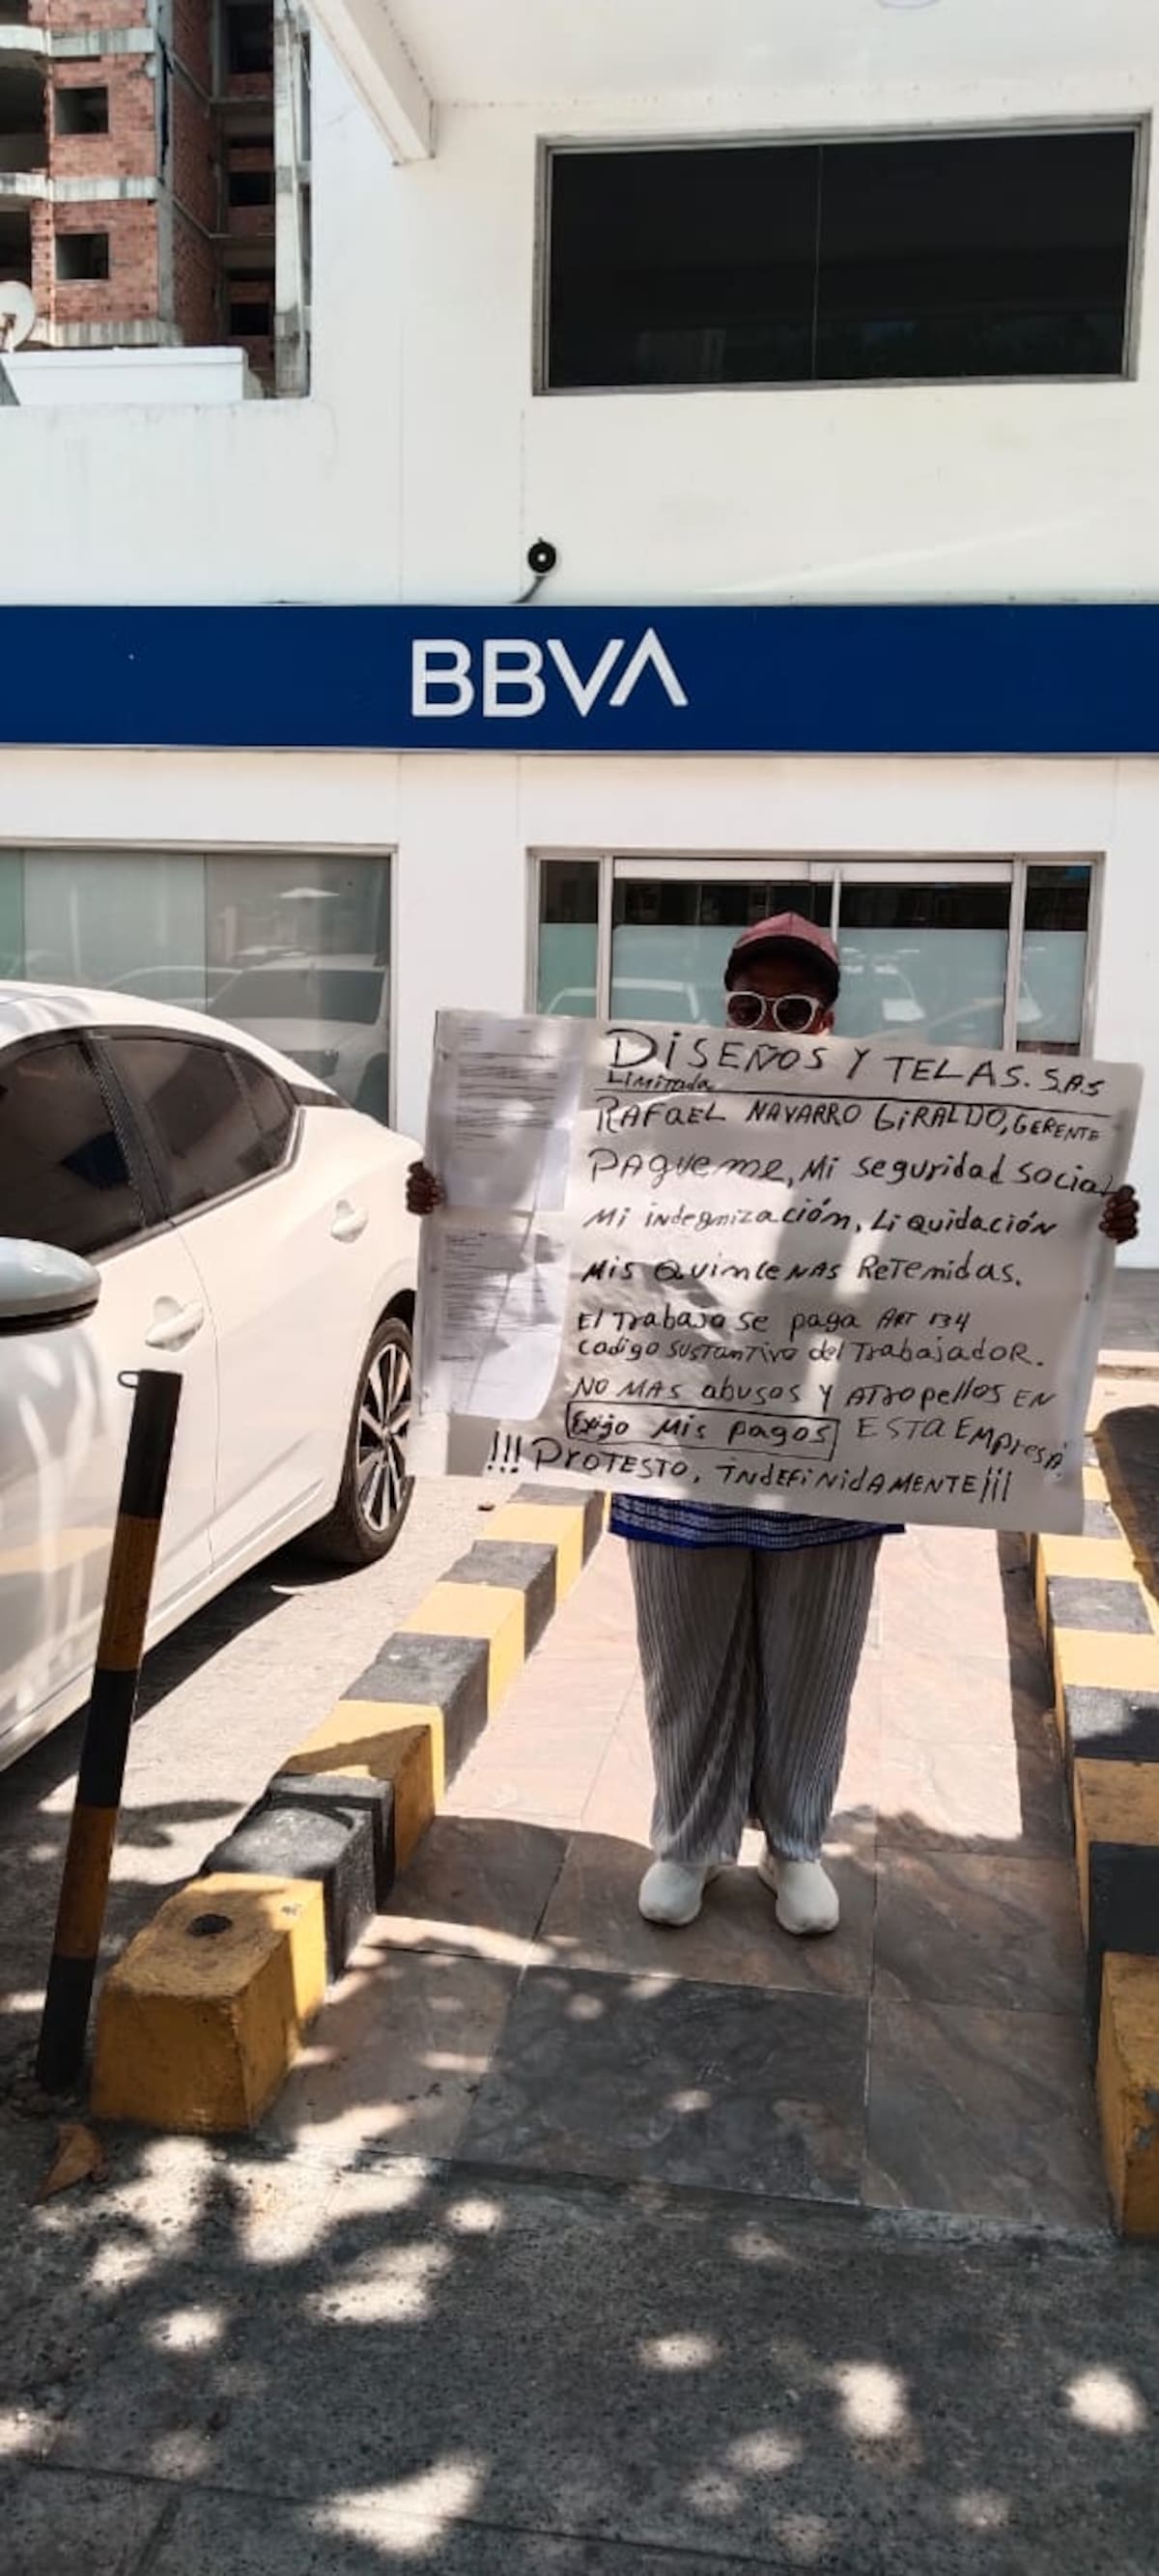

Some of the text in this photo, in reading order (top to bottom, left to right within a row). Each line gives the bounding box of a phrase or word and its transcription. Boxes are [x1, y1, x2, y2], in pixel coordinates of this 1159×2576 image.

[412, 628, 688, 717] BBVA
[846, 1047, 870, 1080] Y
[745, 1099, 862, 1128] NAVARRO
[789, 1311, 861, 1343] paga
[808, 1335, 844, 1361] del
[572, 1376, 609, 1399] NO
[616, 1378, 684, 1400] MAS
[1013, 1389, 1057, 1408] EN
